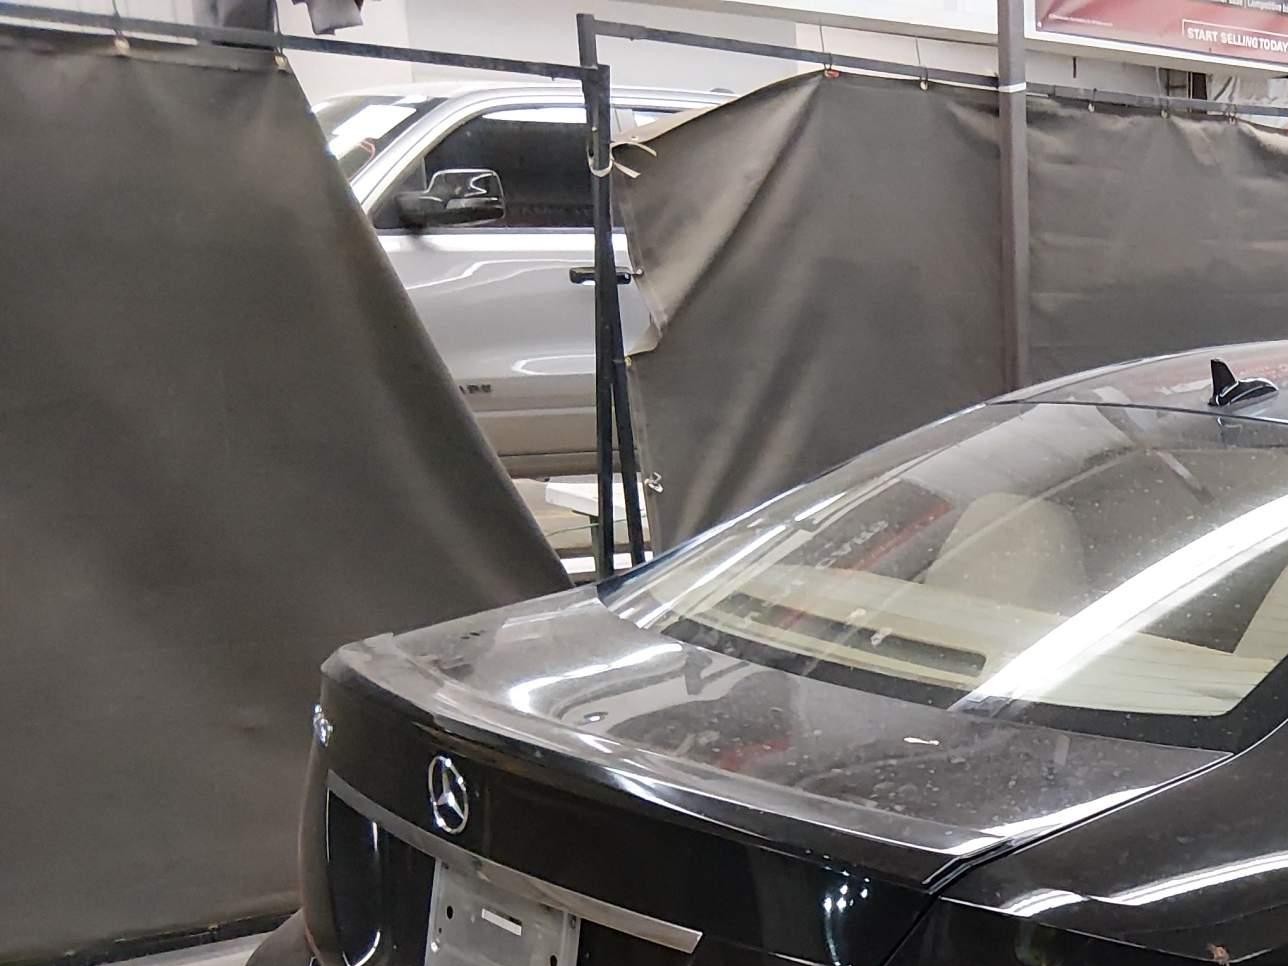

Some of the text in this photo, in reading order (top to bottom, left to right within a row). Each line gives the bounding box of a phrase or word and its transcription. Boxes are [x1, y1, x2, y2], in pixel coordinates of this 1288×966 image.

[1187, 27, 1218, 42] START
[1220, 31, 1258, 49] SELLING
[1259, 37, 1288, 52] TODAY
